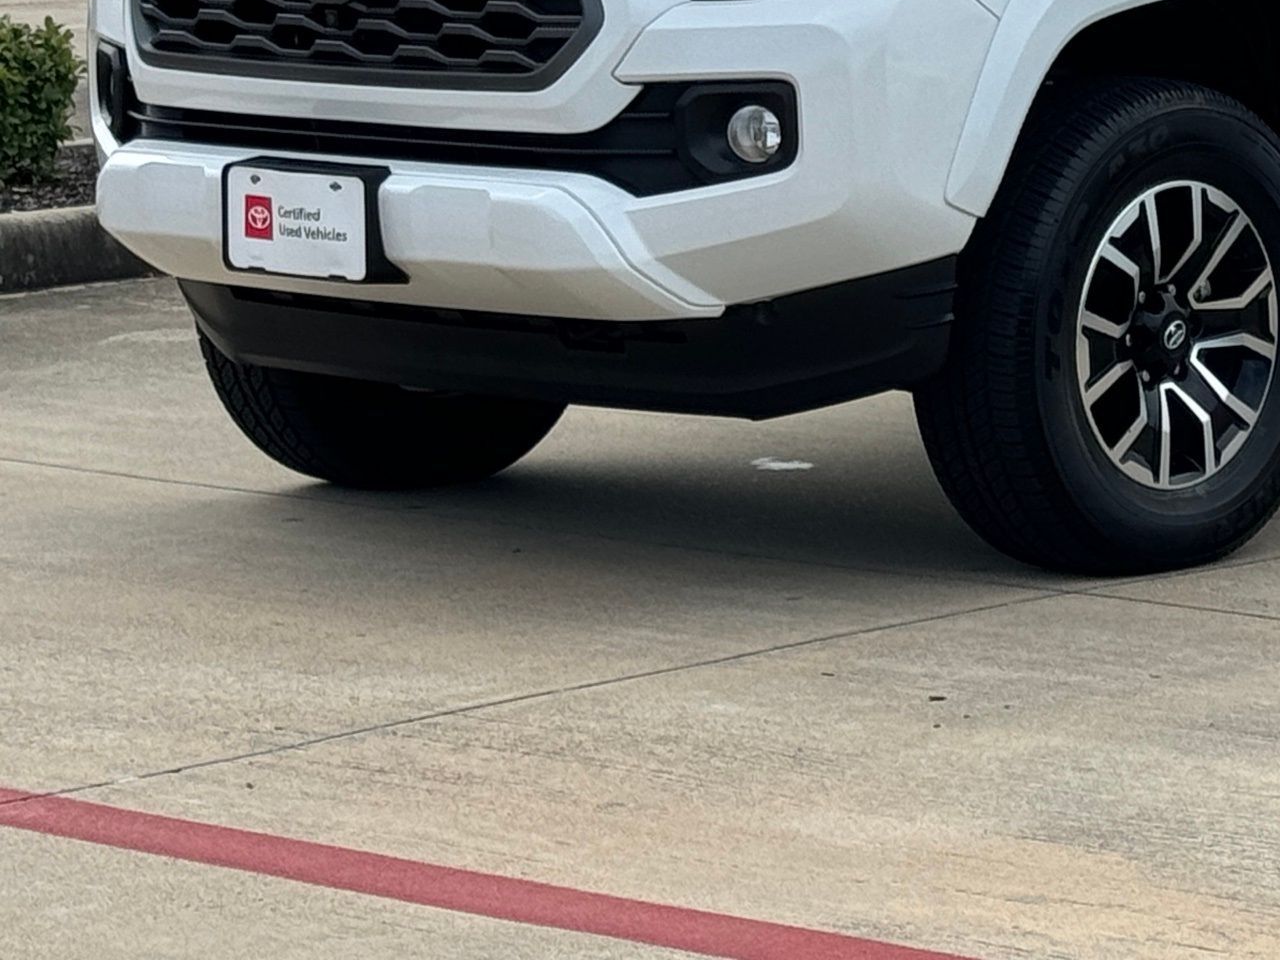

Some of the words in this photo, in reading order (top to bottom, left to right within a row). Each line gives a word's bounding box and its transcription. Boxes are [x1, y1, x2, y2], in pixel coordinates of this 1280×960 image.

[278, 205, 321, 222] Certified
[279, 223, 302, 239] Used
[304, 226, 347, 242] Vehicles
